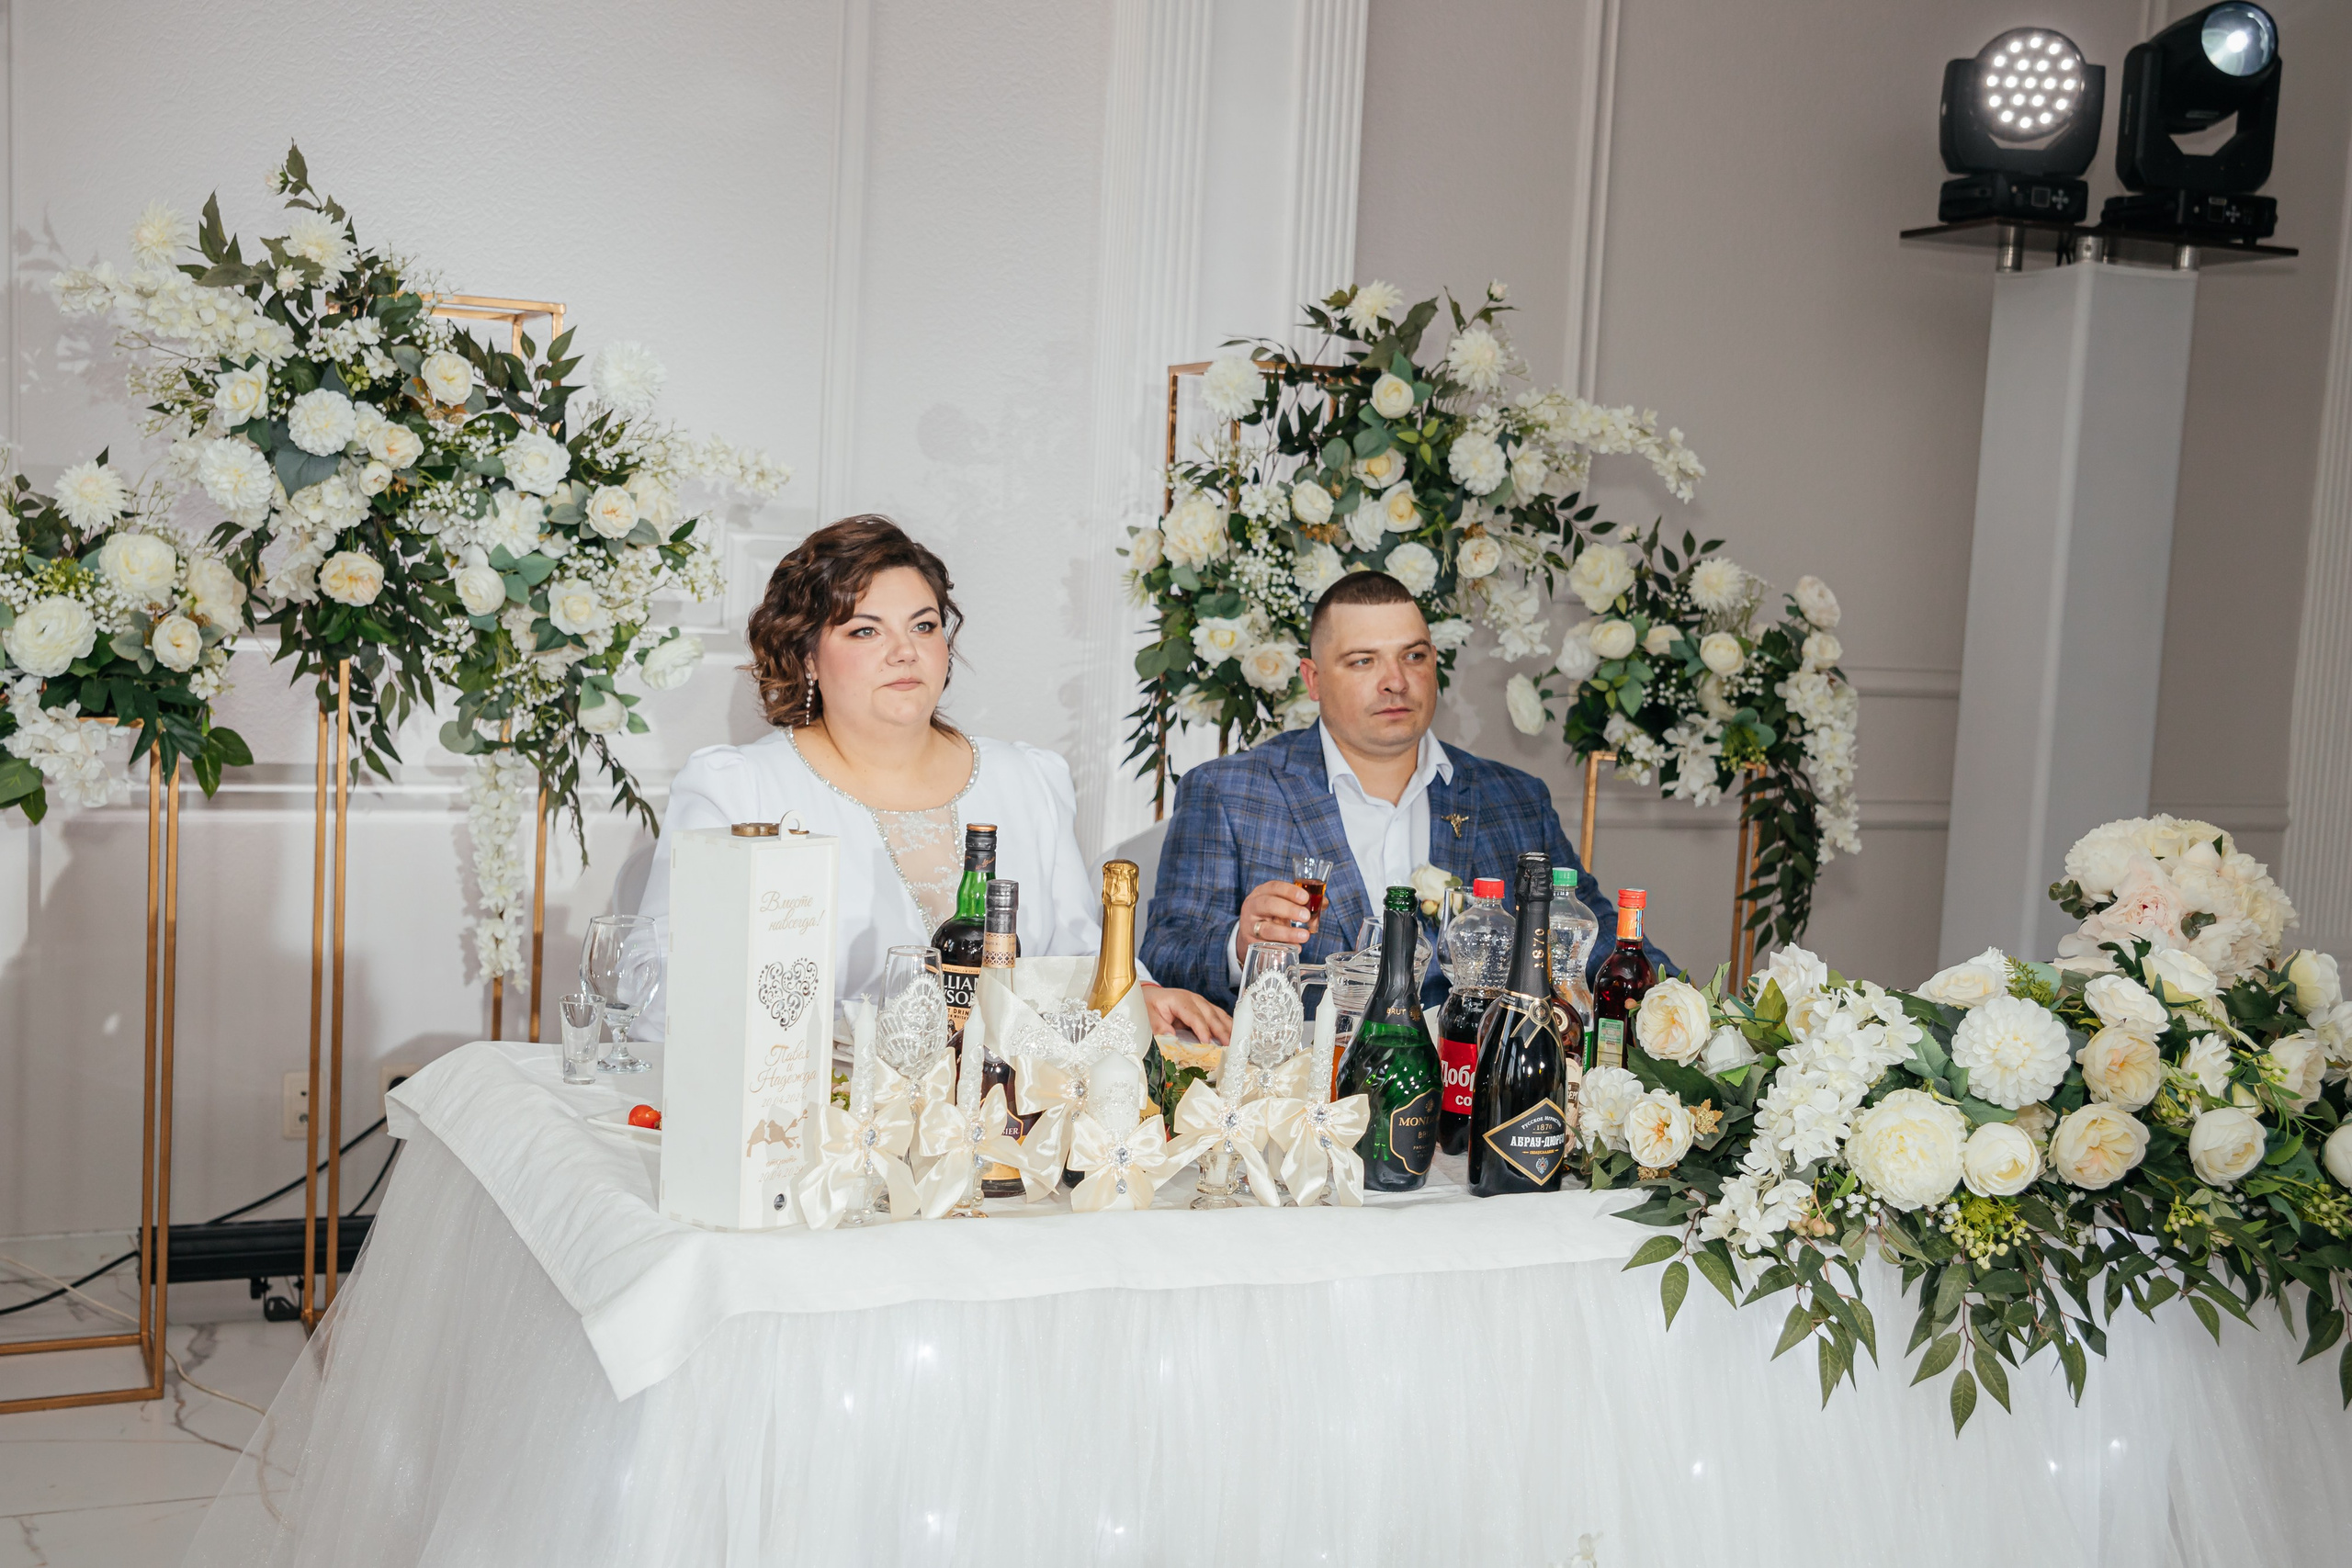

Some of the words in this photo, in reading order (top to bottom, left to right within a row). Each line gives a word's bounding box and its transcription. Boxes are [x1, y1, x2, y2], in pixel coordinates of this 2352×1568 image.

[760, 890, 814, 912] Вместе
[768, 908, 826, 935] навсегда!
[1532, 928, 1545, 969] 1870
[953, 1008, 970, 1017] DRIN
[1386, 1007, 1407, 1016] BRUT
[764, 1039, 810, 1066] Павел
[786, 1062, 795, 1073] и
[749, 1067, 817, 1093] Надежда
